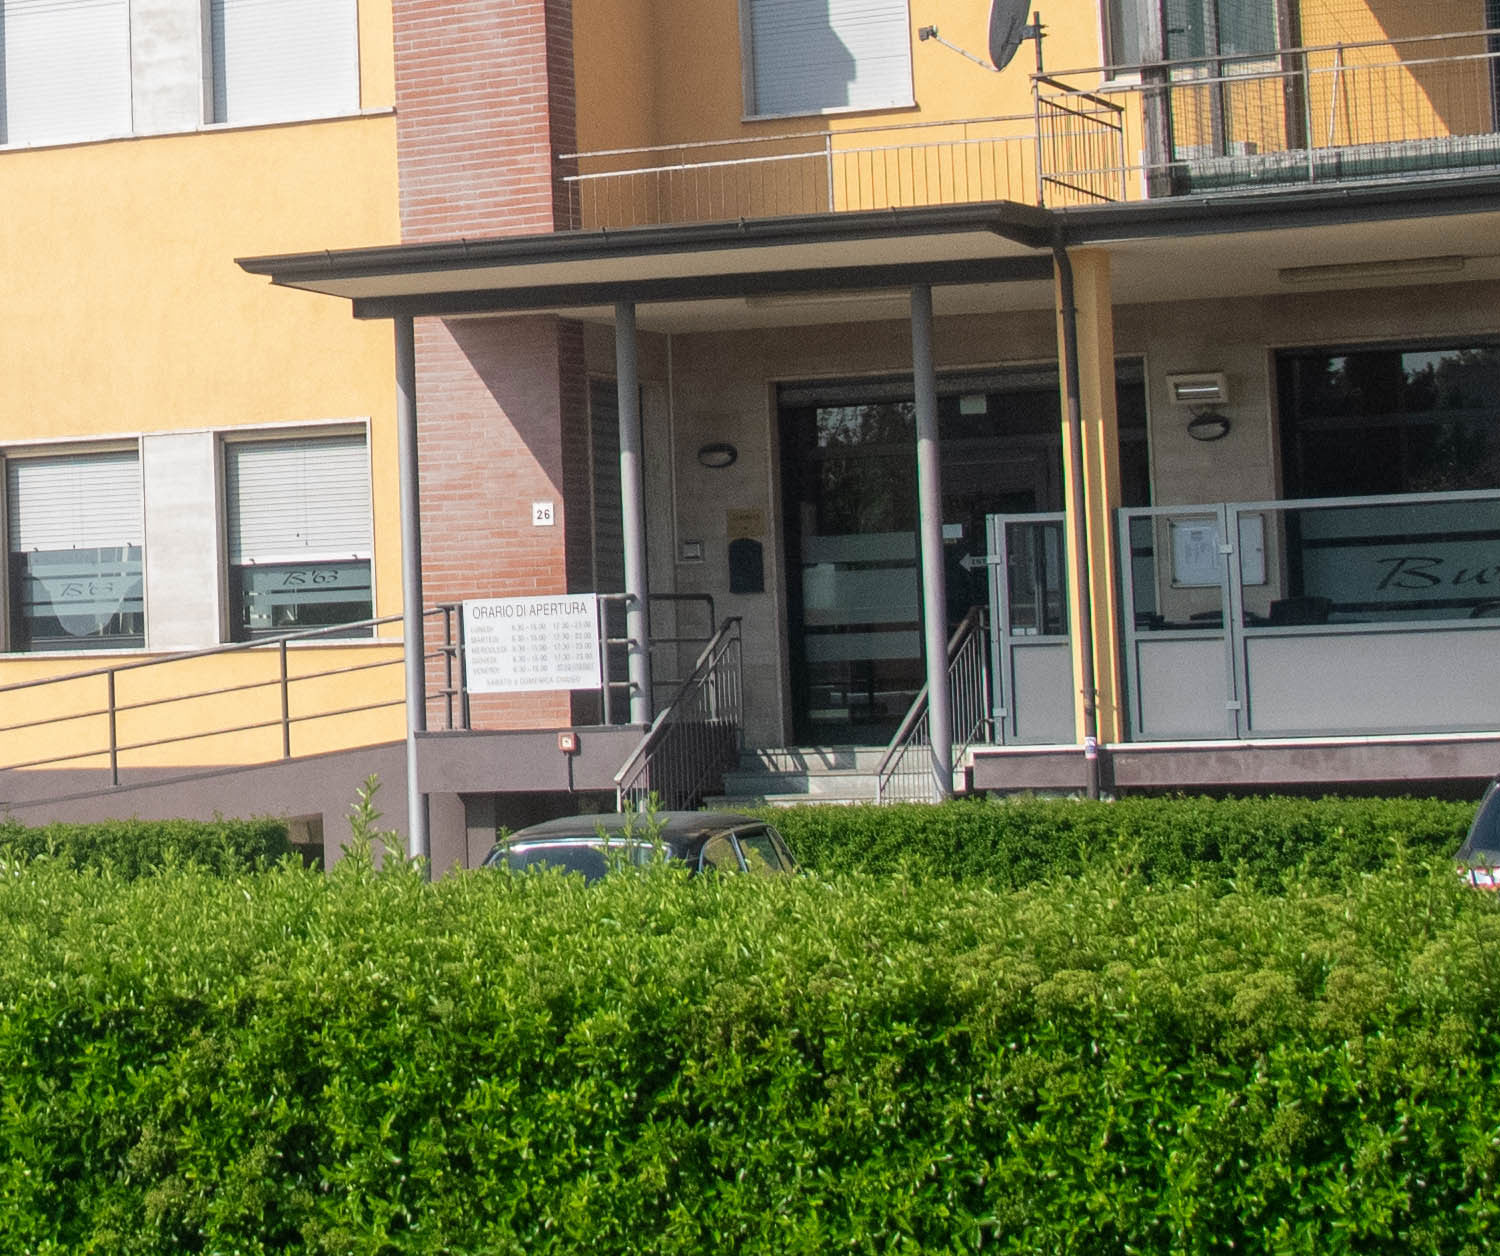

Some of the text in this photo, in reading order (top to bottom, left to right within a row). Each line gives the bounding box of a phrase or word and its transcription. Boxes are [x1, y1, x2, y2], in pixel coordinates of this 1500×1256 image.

[537, 509, 550, 519] 26
[472, 601, 587, 620] ORARIO DI APERTURA
